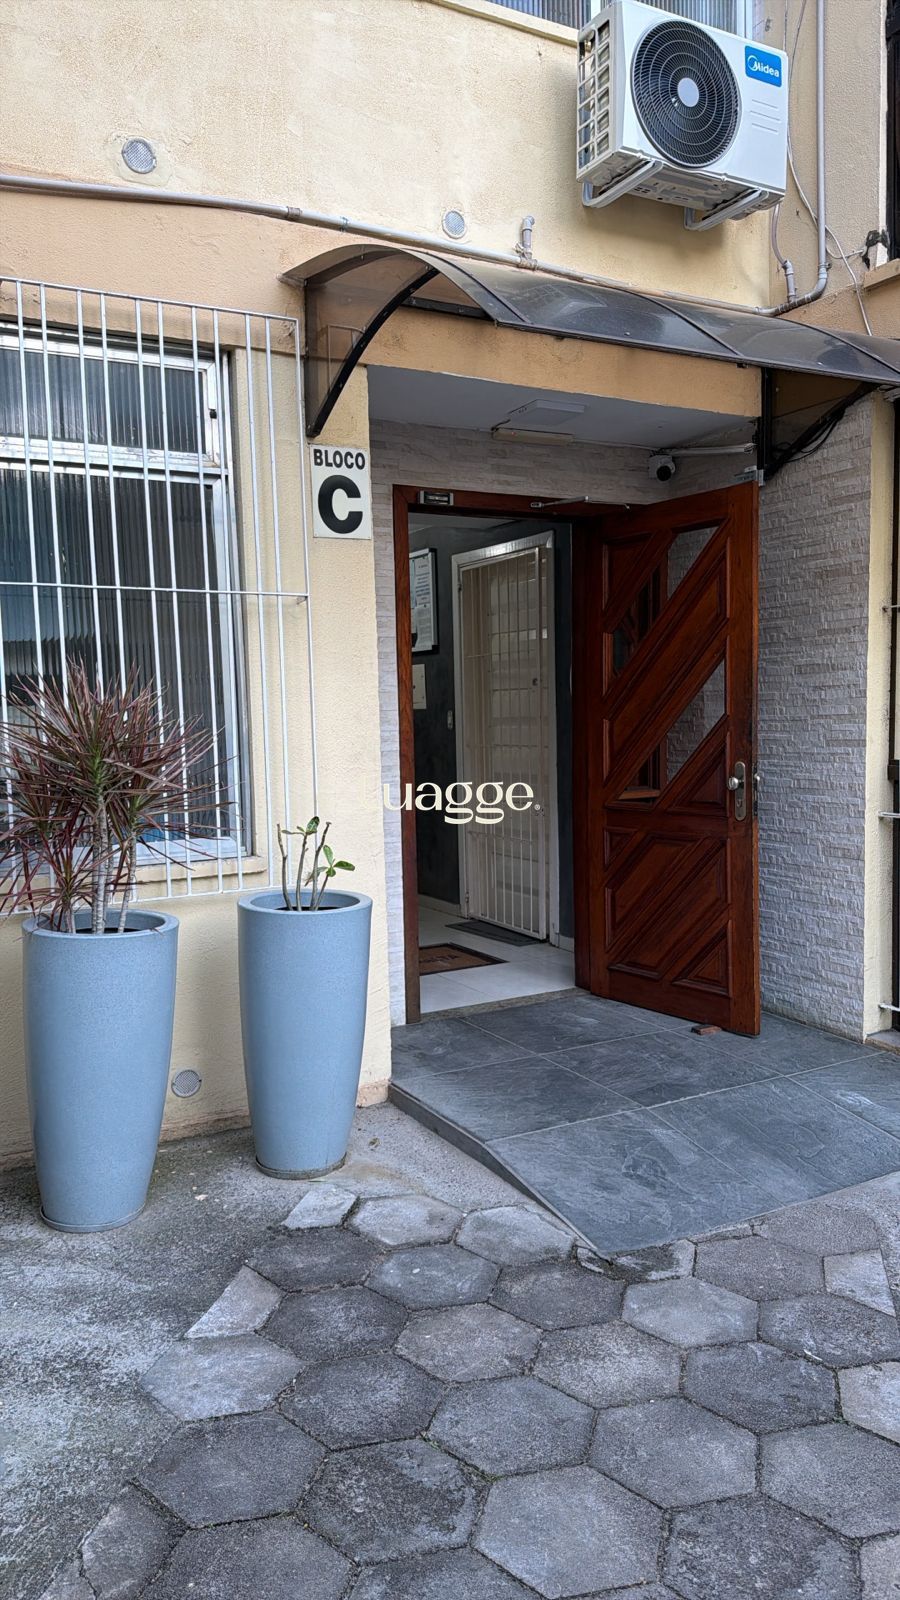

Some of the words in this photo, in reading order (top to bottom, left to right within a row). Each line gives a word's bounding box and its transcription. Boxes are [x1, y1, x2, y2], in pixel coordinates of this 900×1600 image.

[748, 56, 779, 77] Midea
[314, 449, 365, 470] BLOCO
[318, 475, 363, 534] C
